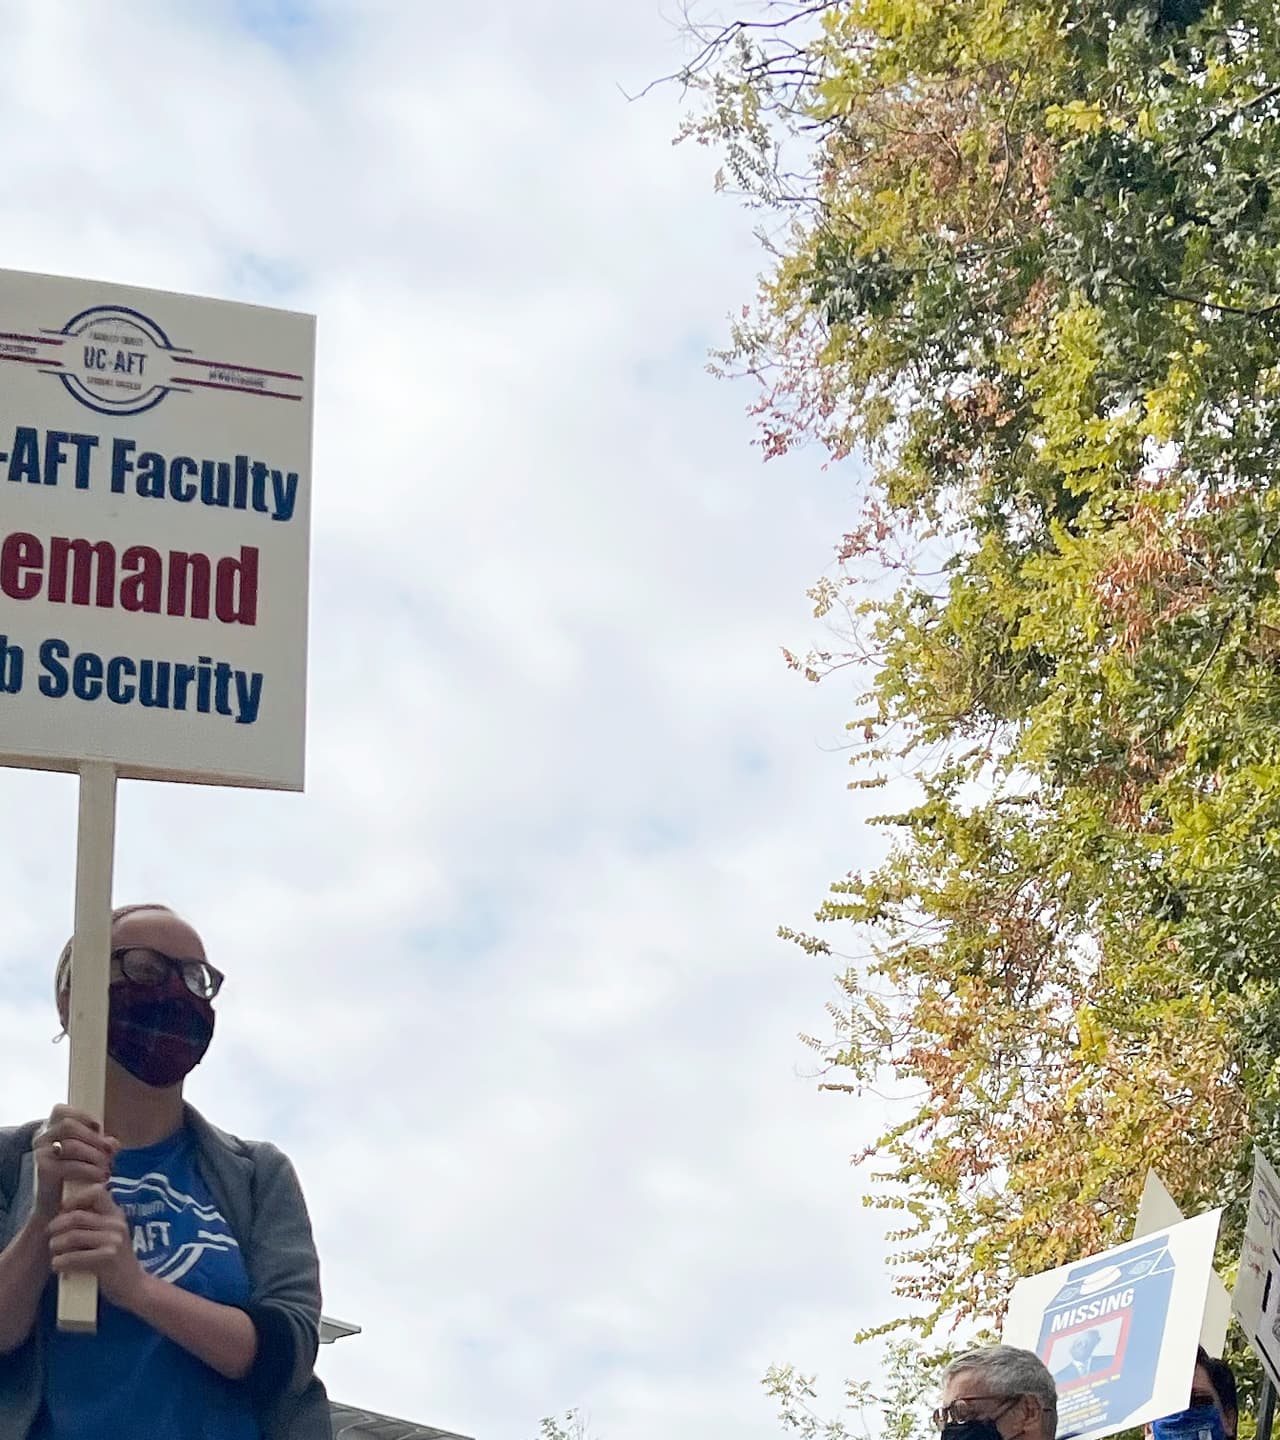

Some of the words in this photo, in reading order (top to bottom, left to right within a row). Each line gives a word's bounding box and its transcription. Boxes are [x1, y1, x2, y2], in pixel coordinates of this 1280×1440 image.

[110, 437, 299, 522] Faculty
[37, 638, 264, 725] Security
[1051, 1287, 1136, 1334] MISSING
